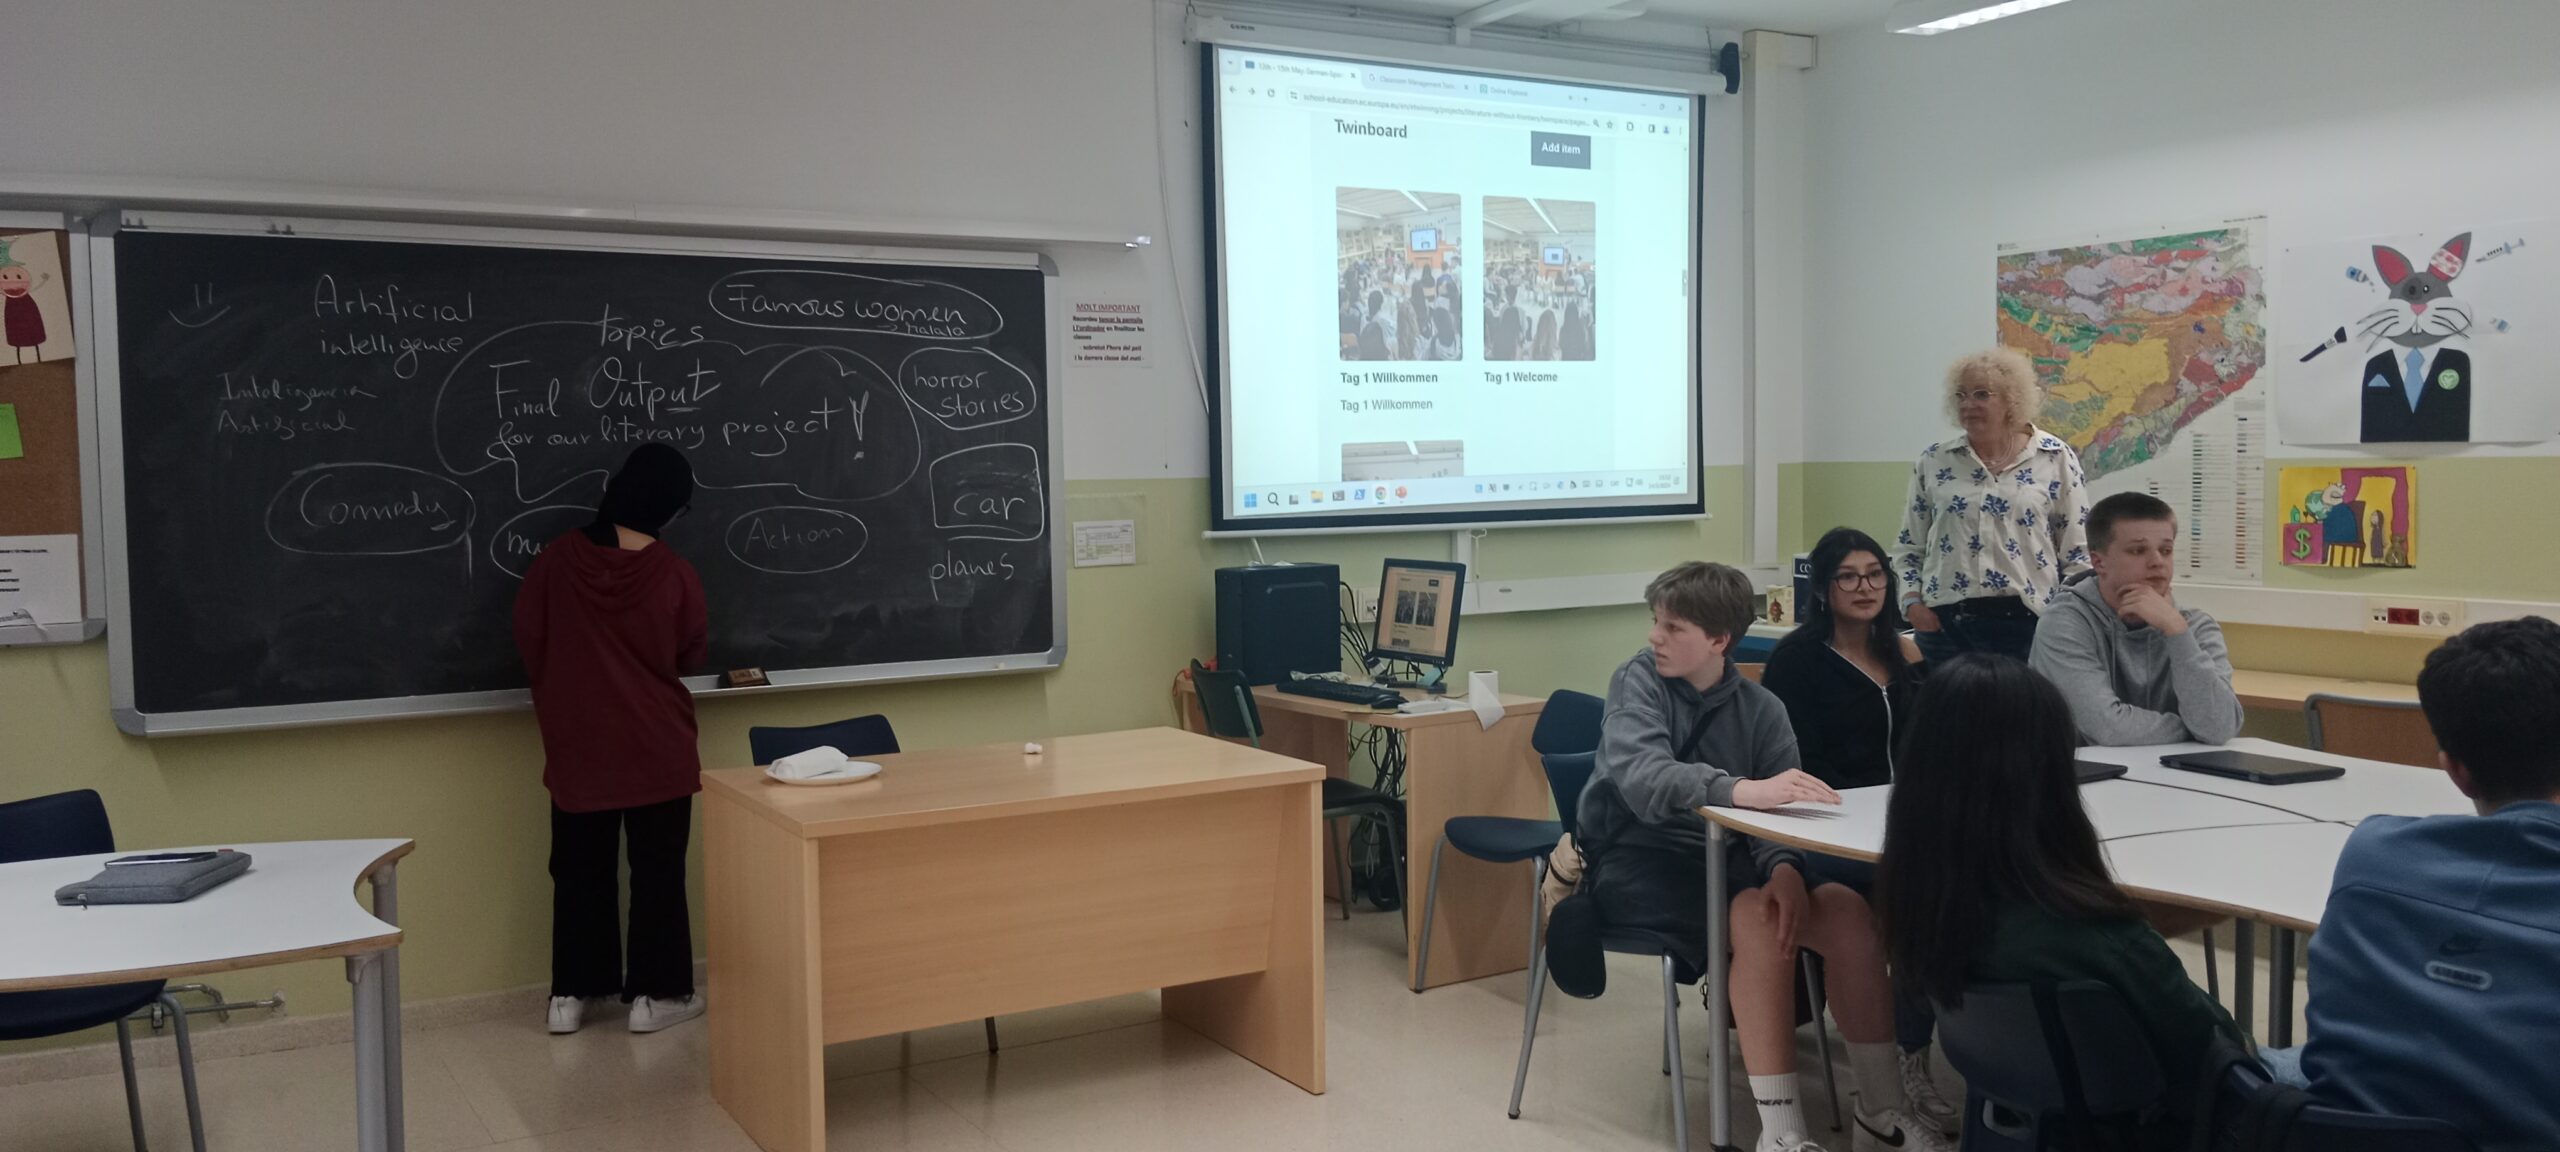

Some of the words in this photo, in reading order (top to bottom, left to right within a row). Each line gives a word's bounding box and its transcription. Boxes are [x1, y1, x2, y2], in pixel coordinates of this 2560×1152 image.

[1334, 118, 1407, 138] Twinboard
[1541, 141, 1560, 153] Add
[1562, 143, 1581, 155] item
[315, 274, 473, 324] Artificial
[726, 284, 845, 318] Famous
[855, 302, 967, 325] women
[1076, 303, 1097, 312] MOLT
[1098, 304, 1141, 313] IMPORTANT
[321, 329, 463, 379] intelligence
[489, 360, 560, 418] Final
[589, 356, 722, 421] Output
[913, 365, 989, 389] horror
[1340, 372, 1360, 386] Tag
[1363, 372, 1369, 384] 1
[1372, 371, 1438, 384] Willkommen
[1484, 371, 1502, 385] Tag
[1505, 371, 1510, 383] 1
[1513, 371, 1558, 383] Welcome
[1340, 399, 1359, 413] Tag
[1363, 399, 1368, 411] 1
[1372, 399, 1433, 411] Willkommen
[496, 421, 534, 458] for
[547, 432, 592, 446] our
[601, 415, 706, 449] literary
[300, 474, 457, 531] Comedy
[953, 492, 1025, 520] car
[744, 517, 844, 553] Action
[928, 549, 1015, 602] planes
